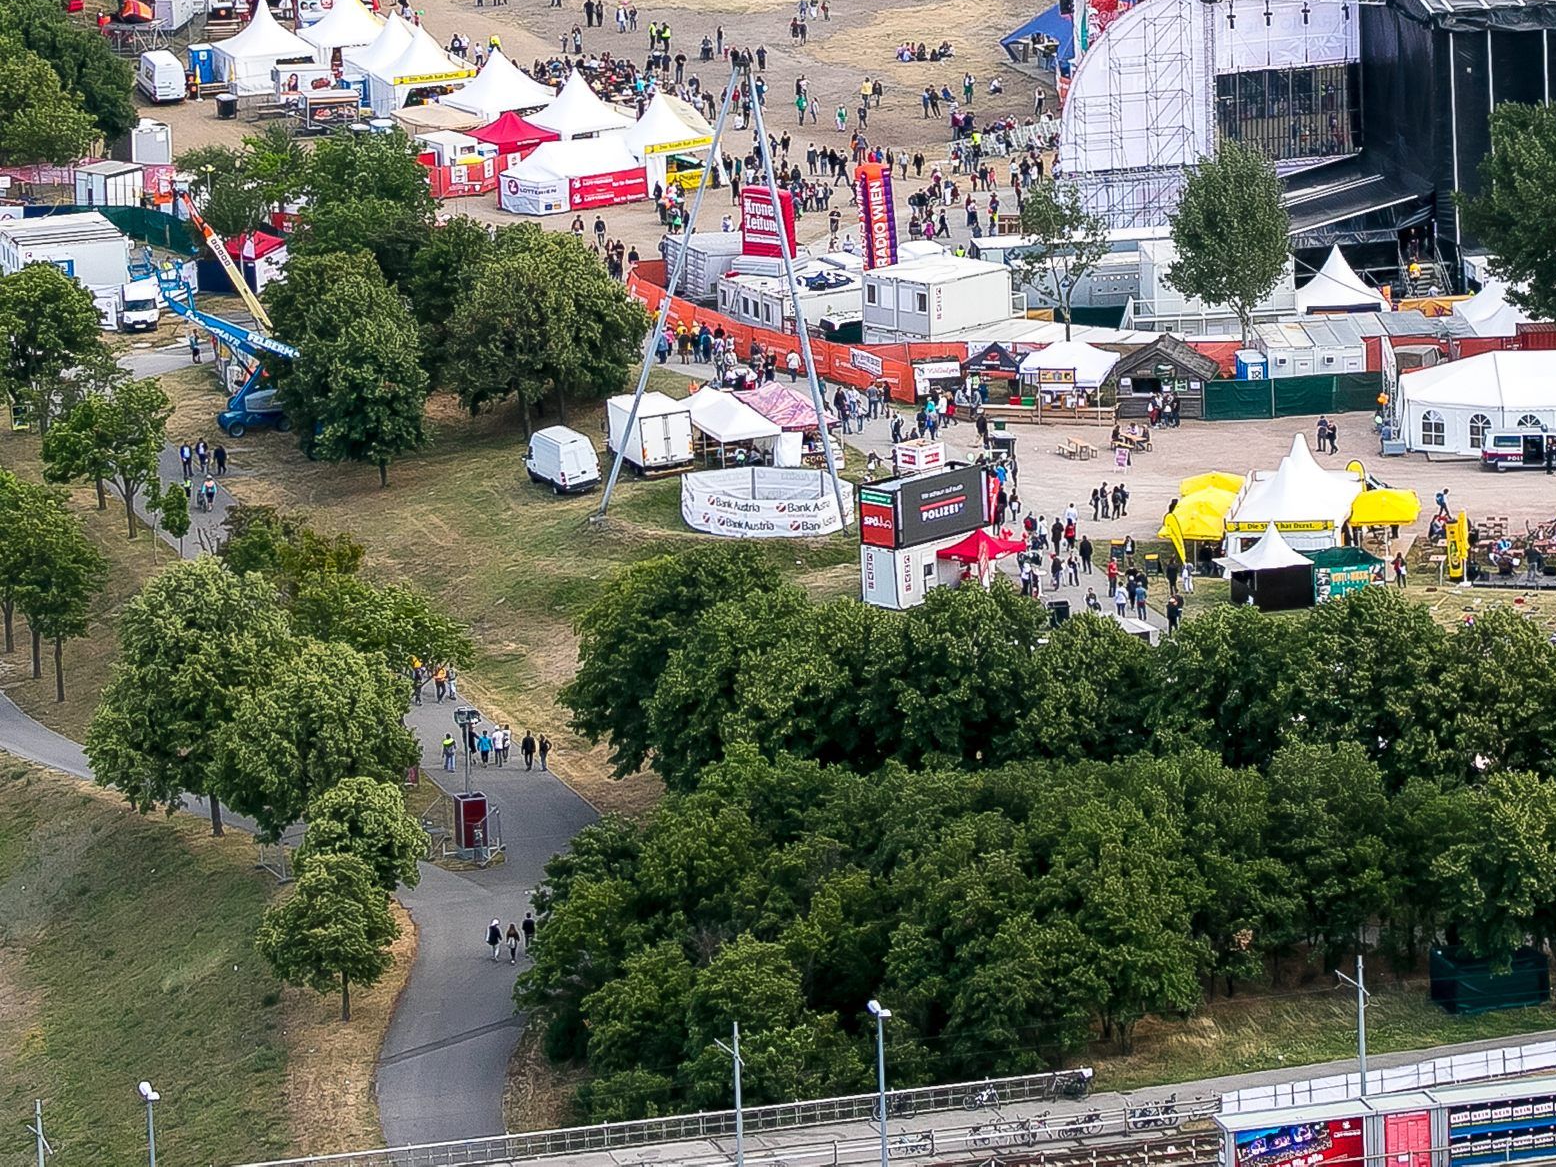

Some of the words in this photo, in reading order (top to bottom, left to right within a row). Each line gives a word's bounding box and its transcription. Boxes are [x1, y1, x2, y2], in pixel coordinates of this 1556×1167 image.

[870, 180, 884, 221] WIEN
[872, 221, 889, 268] RADIO
[715, 496, 734, 509] Bank
[734, 500, 761, 513] Austria
[787, 502, 811, 513] Bank
[922, 503, 959, 522] POLIZEI
[725, 517, 744, 529] Bank
[744, 521, 775, 531] Austria
[801, 522, 821, 531] Ban
